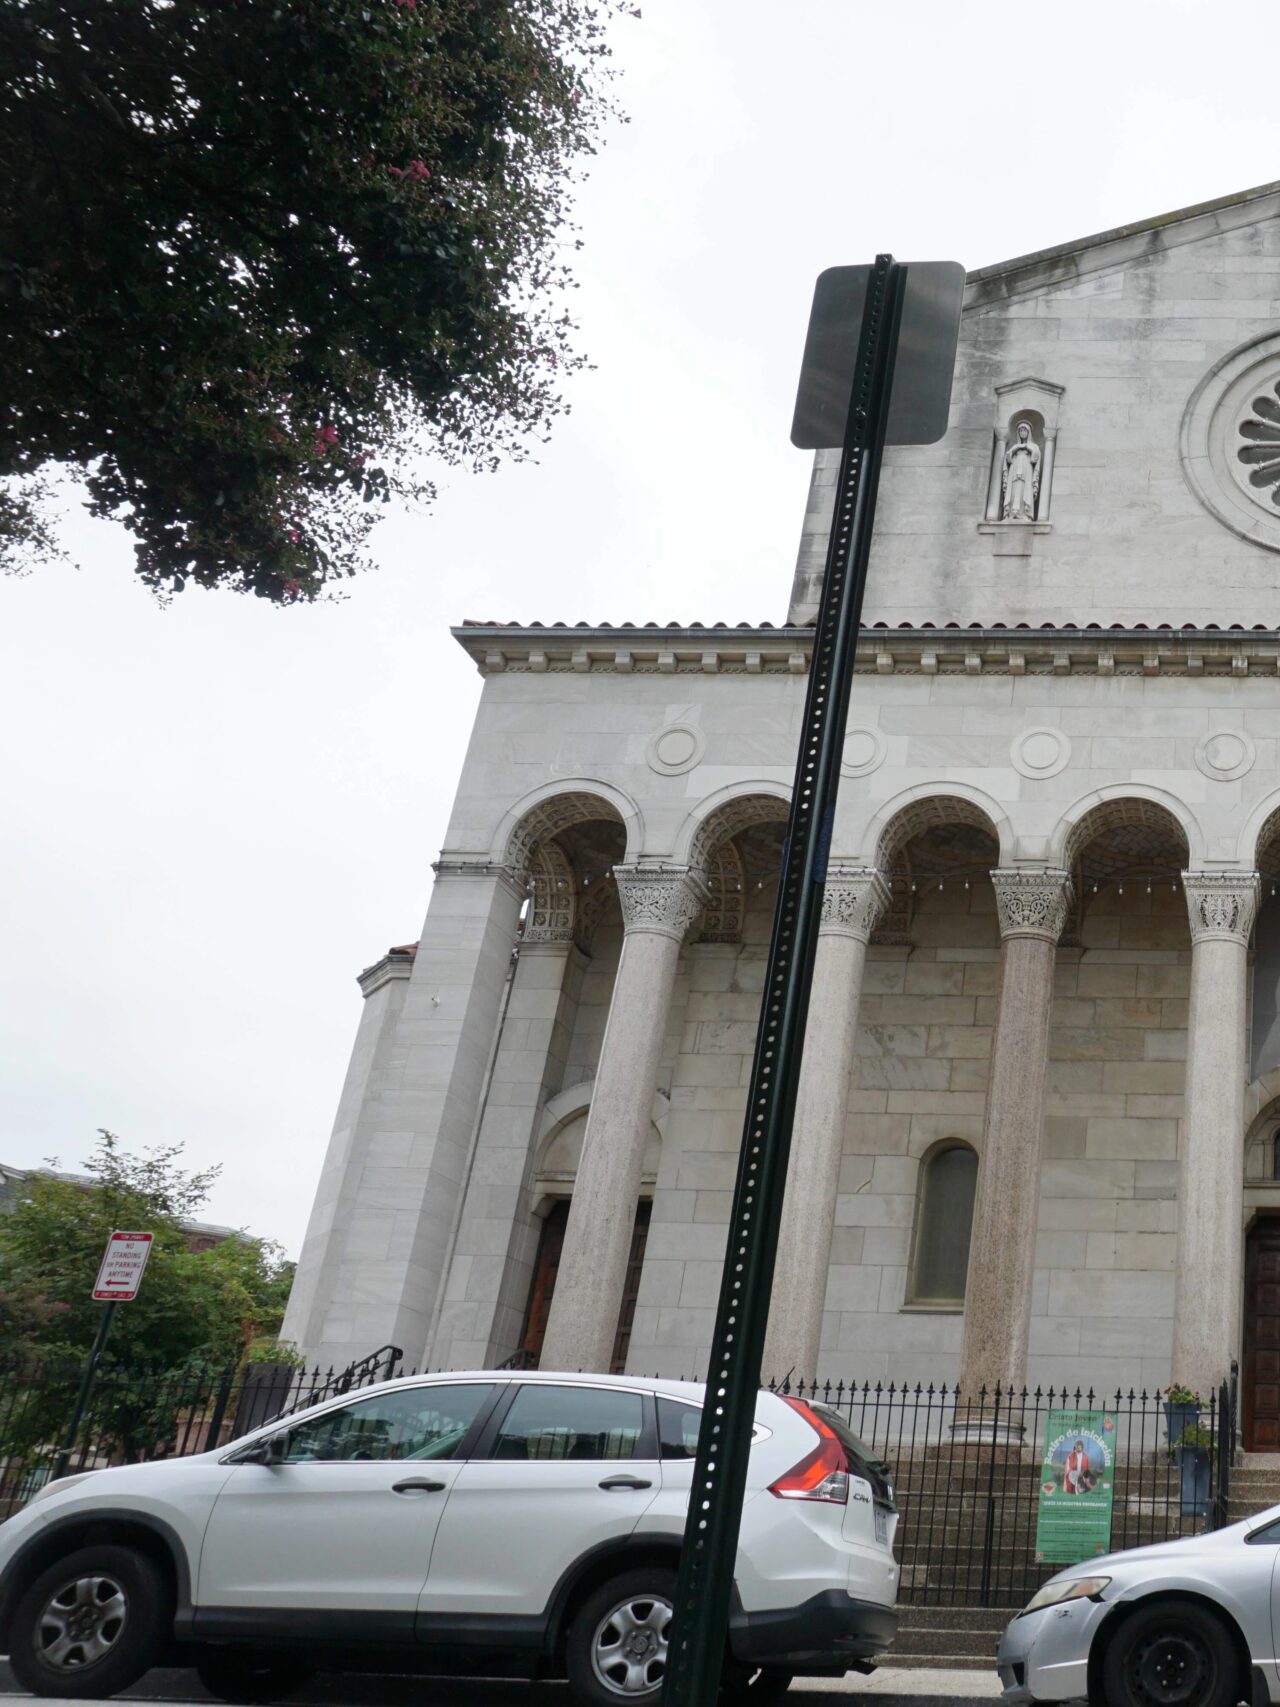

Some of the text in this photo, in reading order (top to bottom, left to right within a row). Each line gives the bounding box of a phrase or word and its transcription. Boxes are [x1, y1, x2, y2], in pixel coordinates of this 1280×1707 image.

[1044, 1427, 1112, 1467] Retiro de iniciación
